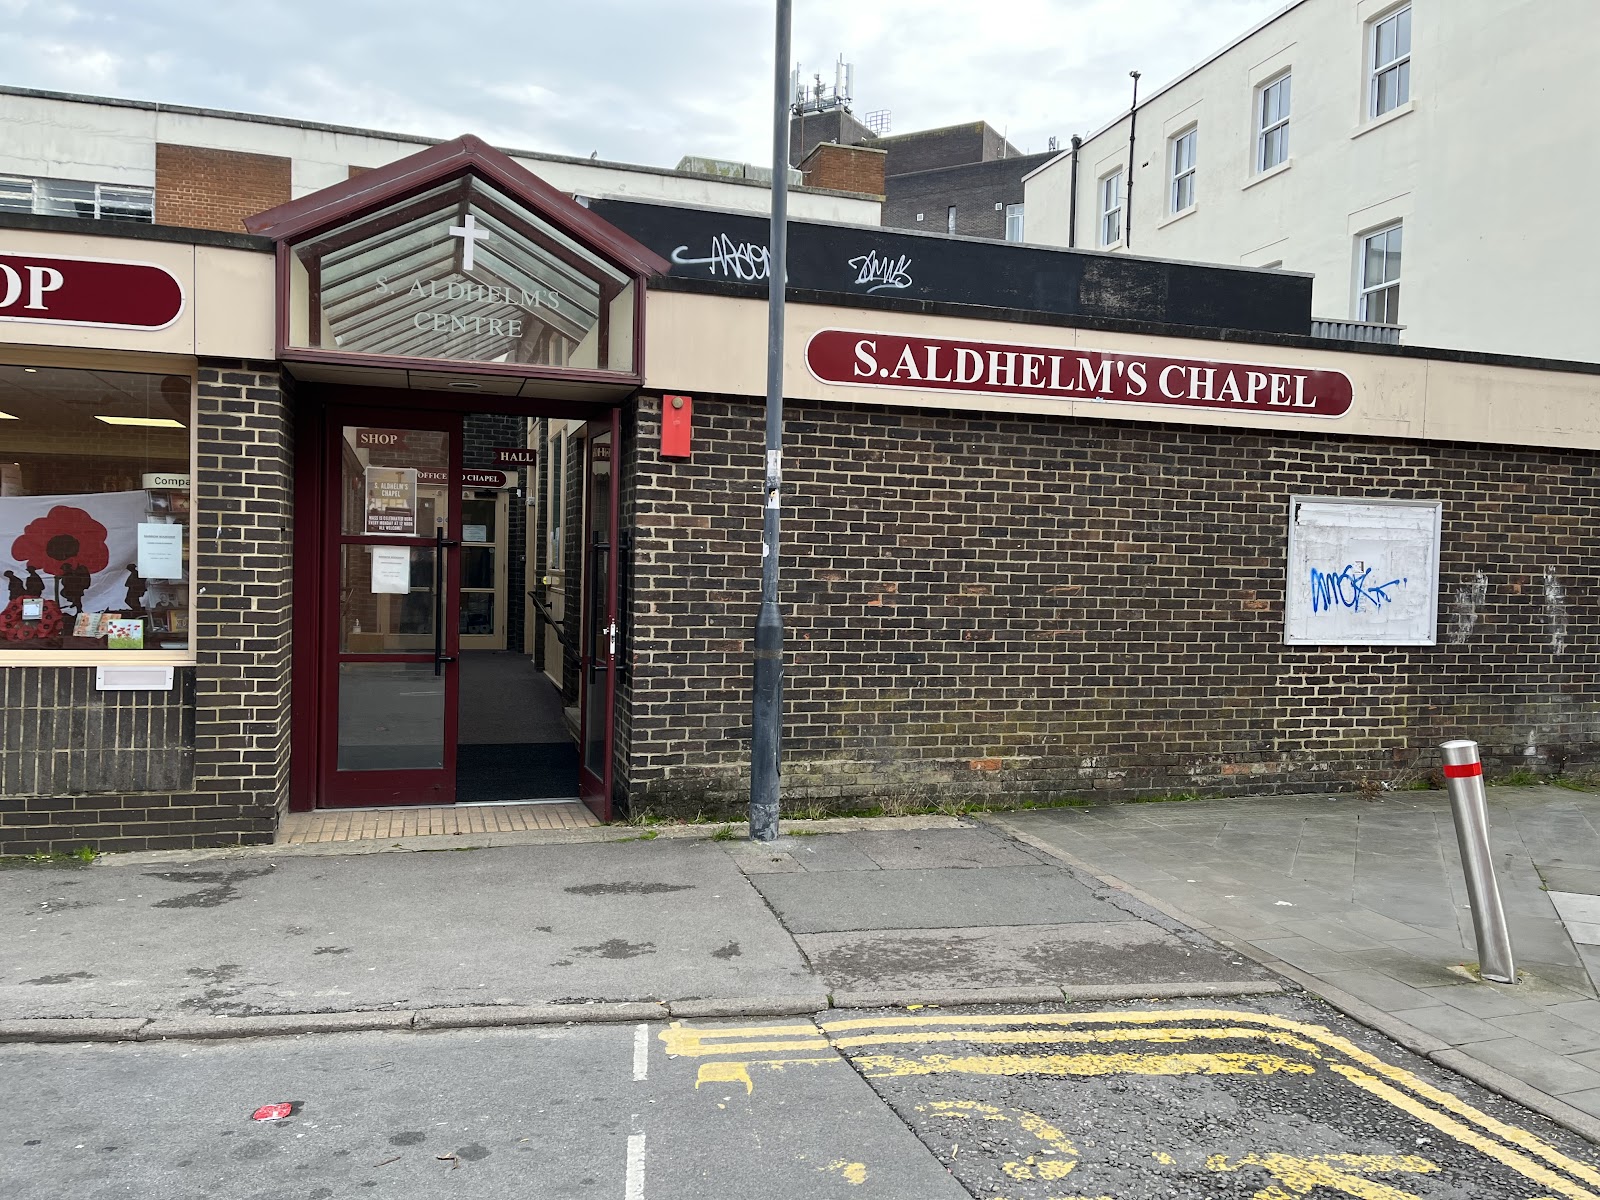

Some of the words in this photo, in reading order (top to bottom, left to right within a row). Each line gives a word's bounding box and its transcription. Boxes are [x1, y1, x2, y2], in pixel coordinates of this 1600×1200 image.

[375, 275, 396, 295] S.
[408, 278, 561, 310] ALDHELM'S
[413, 311, 523, 338] CENTRE
[1158, 364, 1318, 408] CHAPEL
[360, 433, 398, 445] SHOP
[500, 451, 534, 462] HALL
[417, 472, 448, 480] OFFICE
[466, 474, 500, 483] CHAPEL
